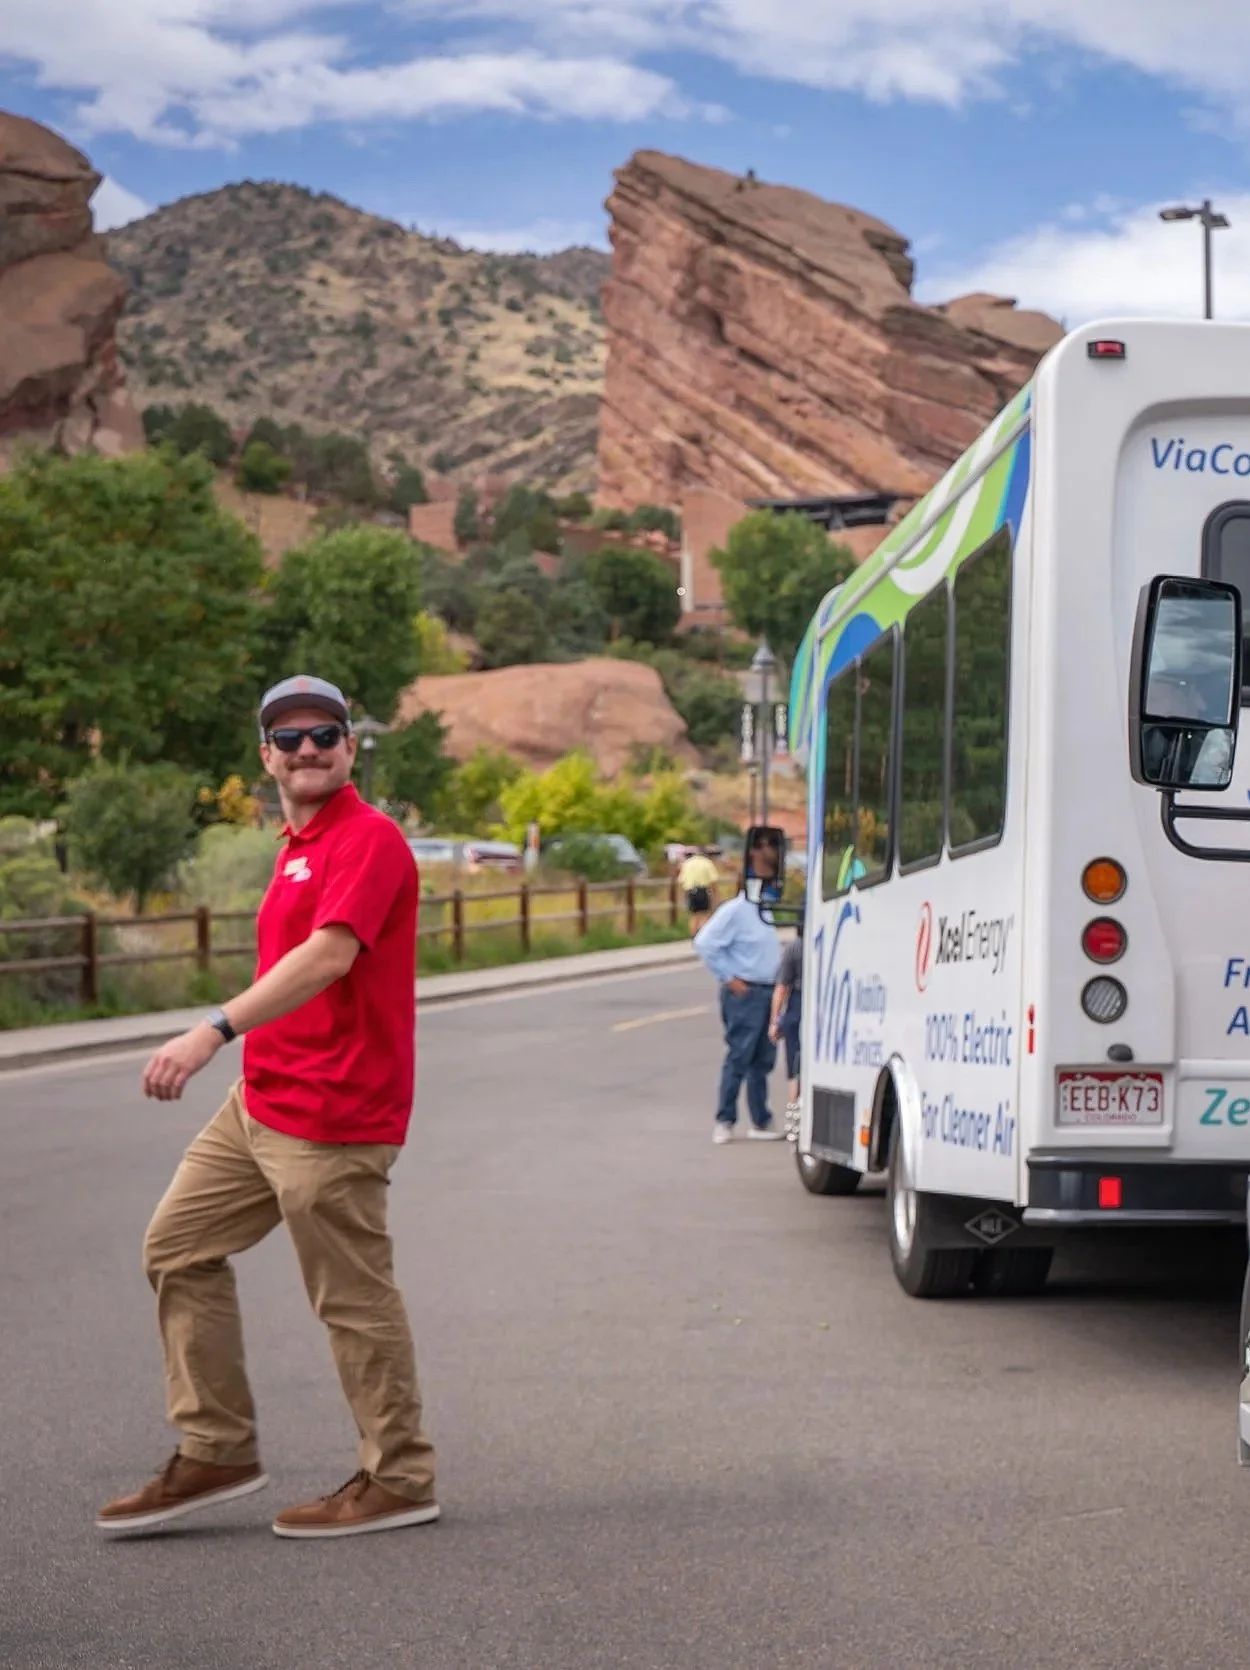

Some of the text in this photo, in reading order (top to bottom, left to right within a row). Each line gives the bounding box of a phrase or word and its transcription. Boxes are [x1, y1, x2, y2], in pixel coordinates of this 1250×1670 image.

[925, 1009, 1012, 1066] 100% Electric
[941, 1093, 990, 1151] Cleaner
[993, 1100, 1015, 1157] Air
